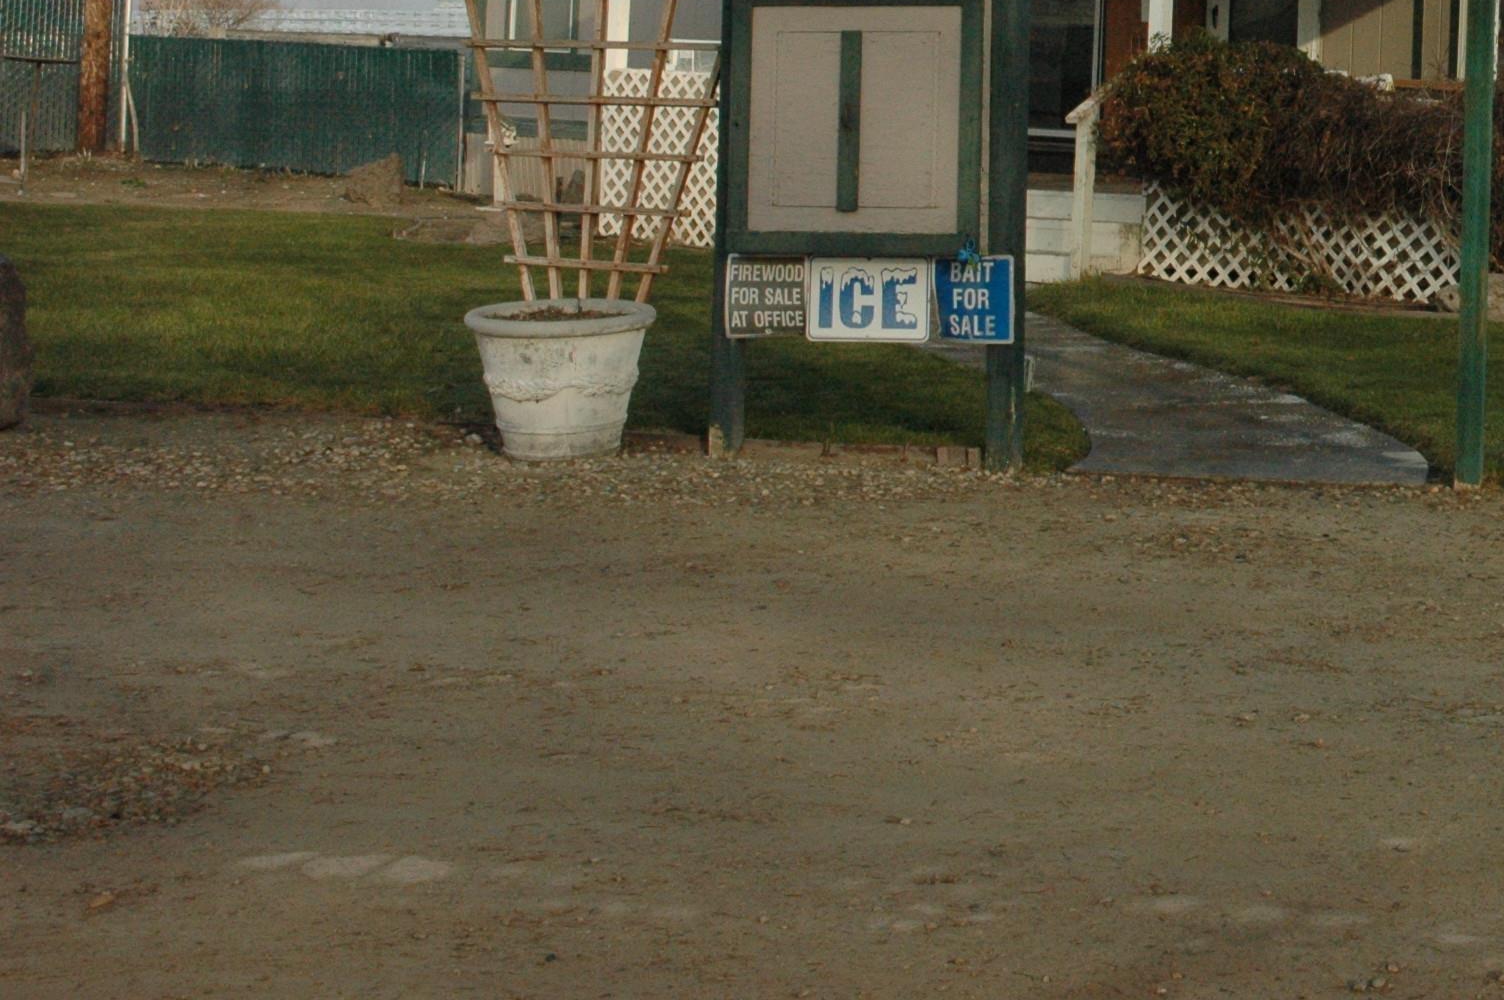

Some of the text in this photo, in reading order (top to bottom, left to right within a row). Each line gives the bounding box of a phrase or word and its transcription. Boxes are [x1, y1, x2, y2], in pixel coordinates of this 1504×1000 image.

[730, 264, 804, 282] FIREWOOD
[950, 261, 995, 283] BAIT
[731, 287, 802, 305] FOR SALE
[818, 266, 918, 329] ICE
[952, 288, 990, 310] FOR
[731, 310, 804, 328] AT OFFICE
[949, 314, 996, 336] SALE
